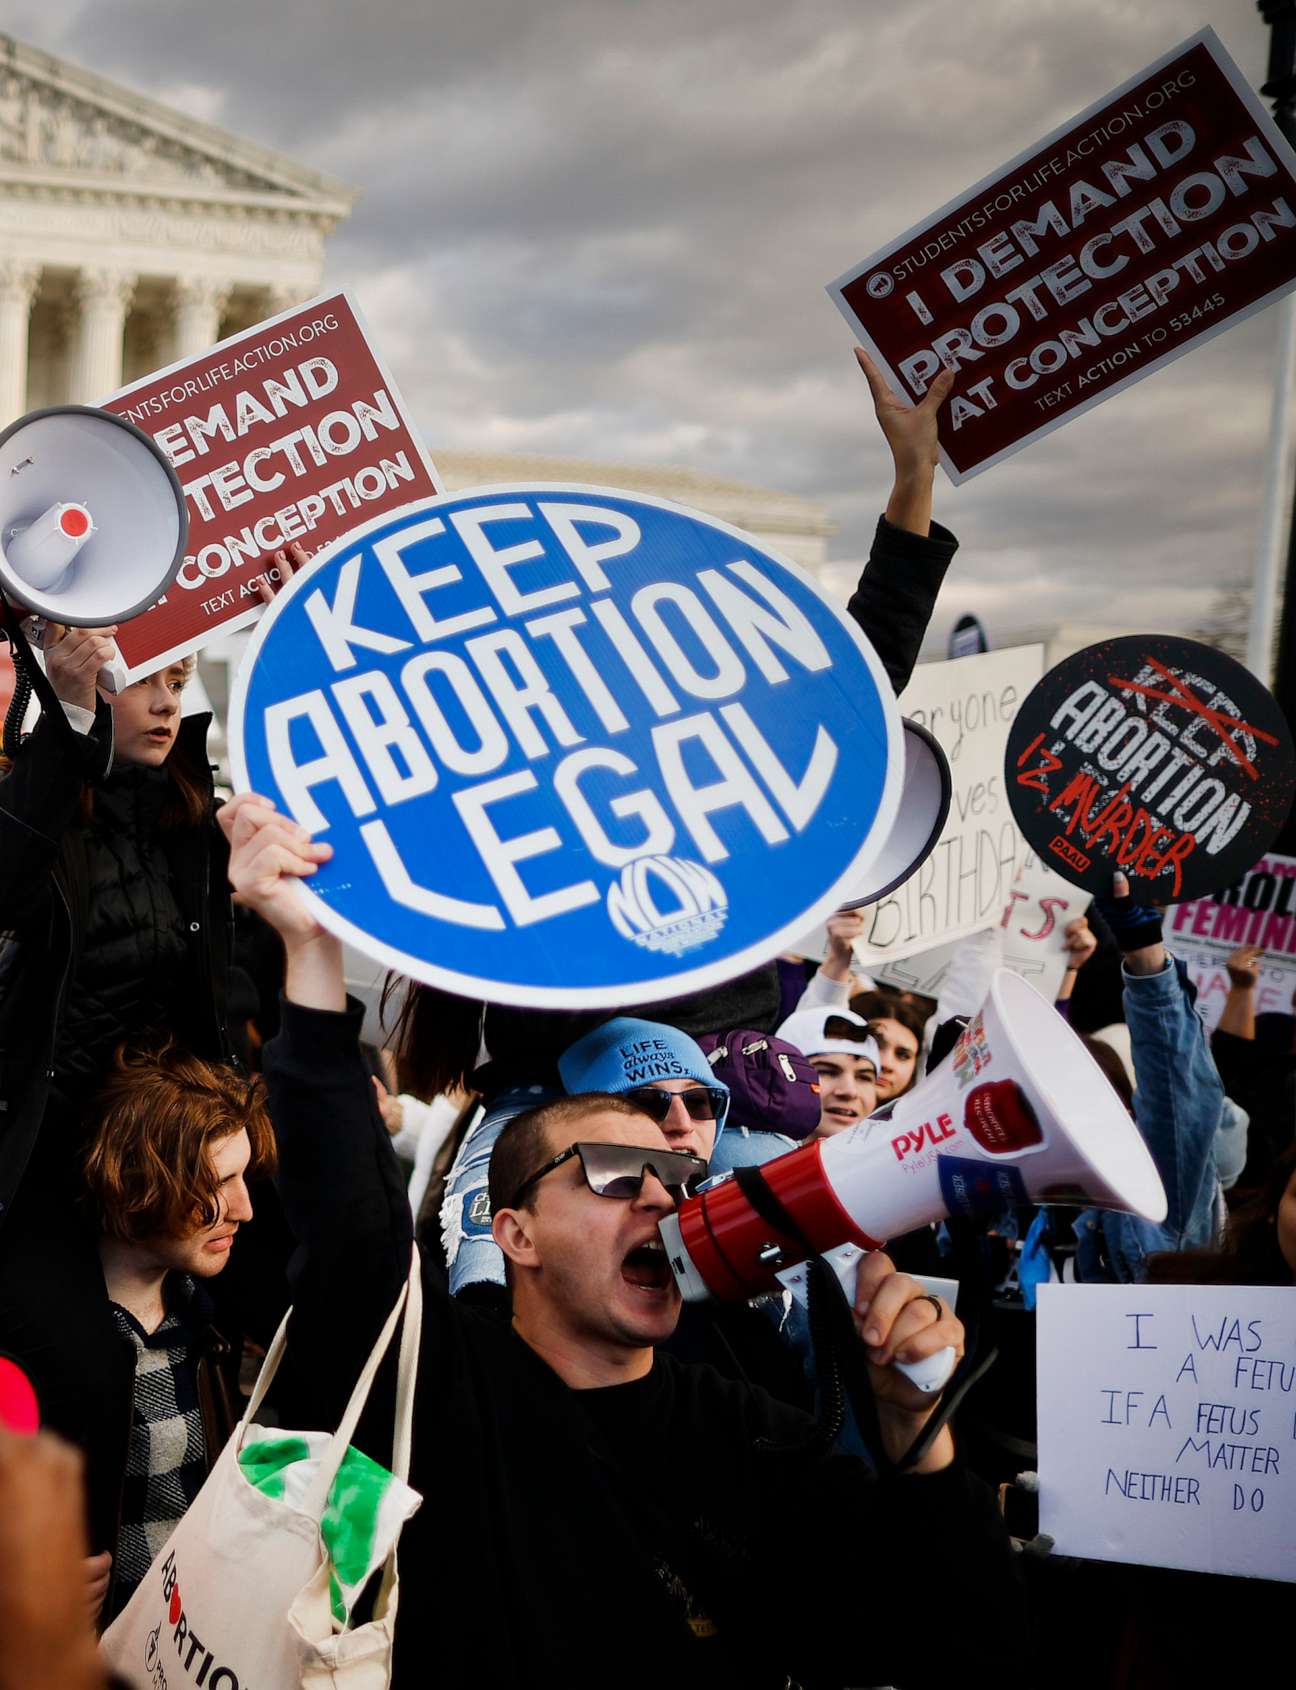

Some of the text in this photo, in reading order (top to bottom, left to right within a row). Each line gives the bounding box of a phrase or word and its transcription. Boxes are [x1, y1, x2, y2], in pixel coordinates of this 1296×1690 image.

[893, 69, 1197, 281] STUDENTSFORLIFEACTION.ORG
[906, 119, 1197, 326] I DEMAND
[898, 135, 1280, 396] PROTECTION
[951, 196, 1296, 431] AT CONCEPTION
[1035, 293, 1226, 411] TEXT ACTION TO 53445
[154, 355, 340, 468] EMAND
[182, 388, 401, 523] TECTION
[175, 451, 415, 591] CONCEPTION
[200, 590, 235, 616] TEXT
[303, 501, 642, 672] KEEP
[264, 560, 832, 834] ABORTION
[910, 684, 1019, 763] eryone
[359, 702, 840, 930] LEGAL
[955, 775, 999, 823] ves
[1049, 679, 1253, 856] ABORTION
[867, 821, 1018, 948] BIRTHDA
[1050, 770, 1197, 898] MURDER
[607, 854, 729, 941] NOW
[619, 1039, 668, 1058] LIFE
[891, 1112, 957, 1161] PYLE
[1125, 1313, 1263, 1352] I WAS
[1175, 1352, 1199, 1384] A
[1100, 1390, 1145, 1425] IF
[1148, 1394, 1173, 1430] A
[1196, 1402, 1262, 1436] FETUS
[1175, 1436, 1281, 1475] MATTER
[1105, 1468, 1201, 1505] NEITHER
